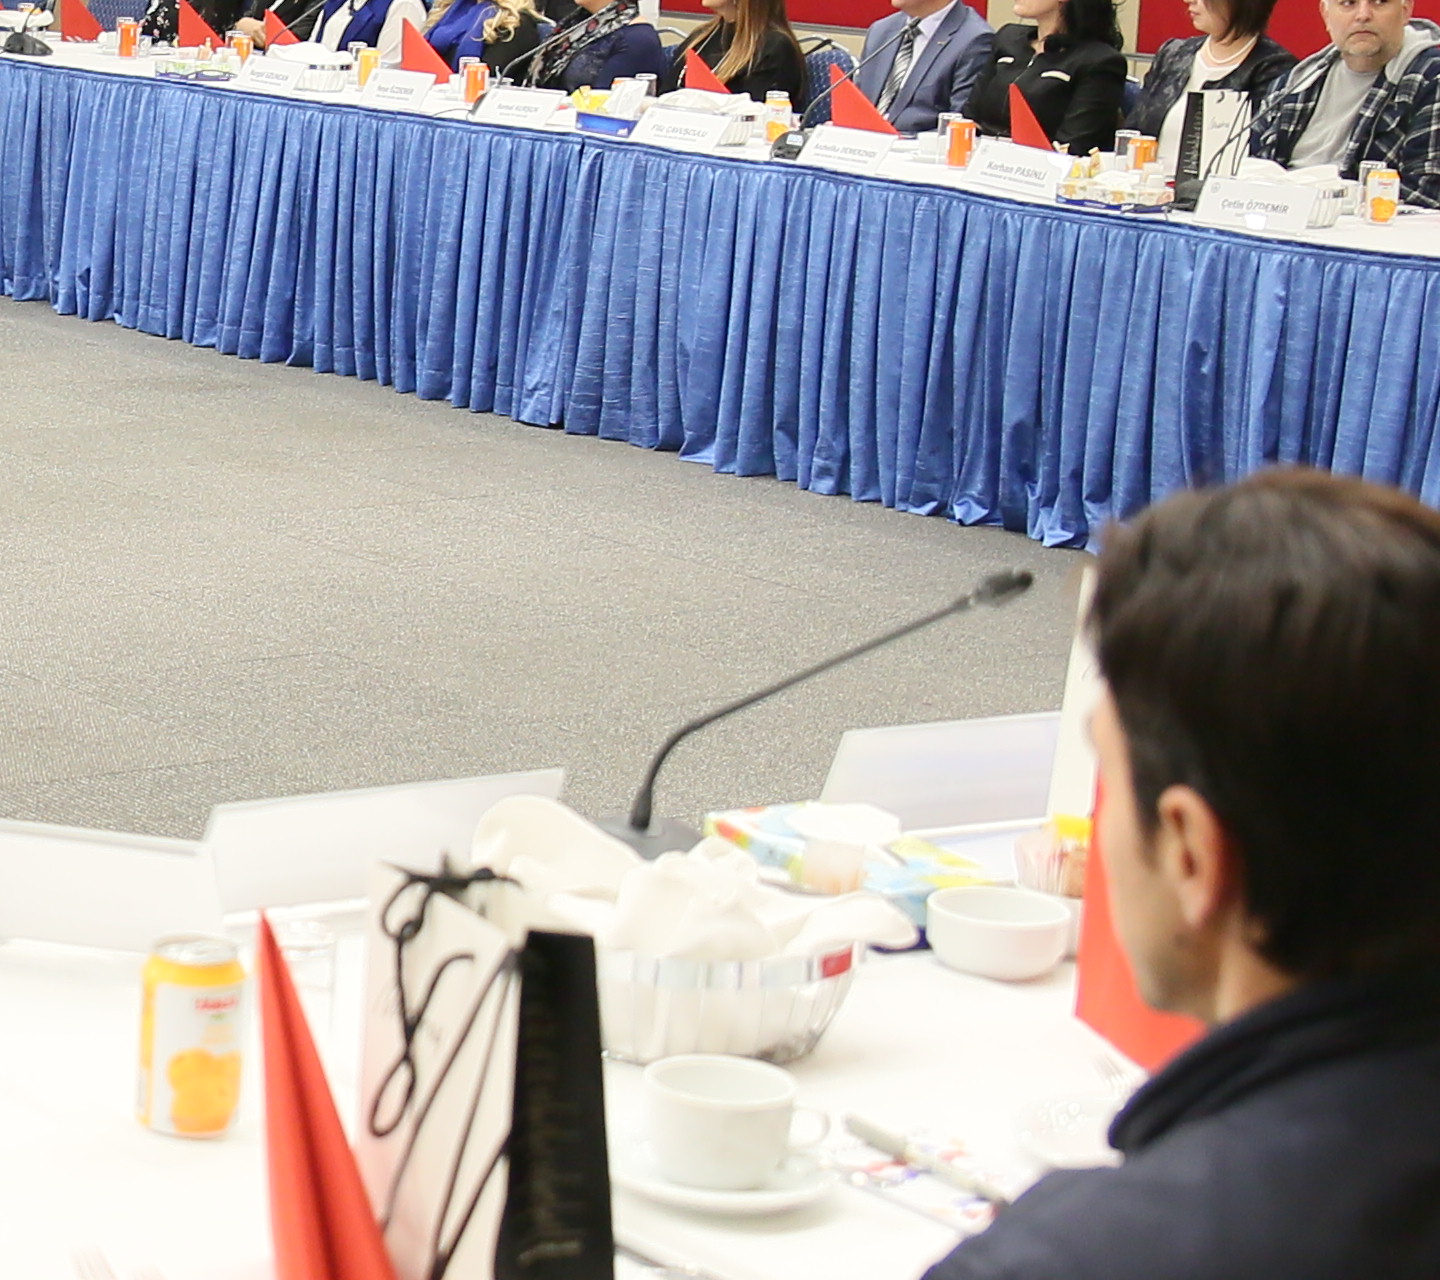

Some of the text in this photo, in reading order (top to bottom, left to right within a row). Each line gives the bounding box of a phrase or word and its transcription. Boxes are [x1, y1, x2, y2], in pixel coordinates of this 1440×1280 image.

[987, 161, 1014, 174] Korhan
[1221, 198, 1244, 210] Çetin
[1246, 199, 1289, 214] ÖZDEMİR
